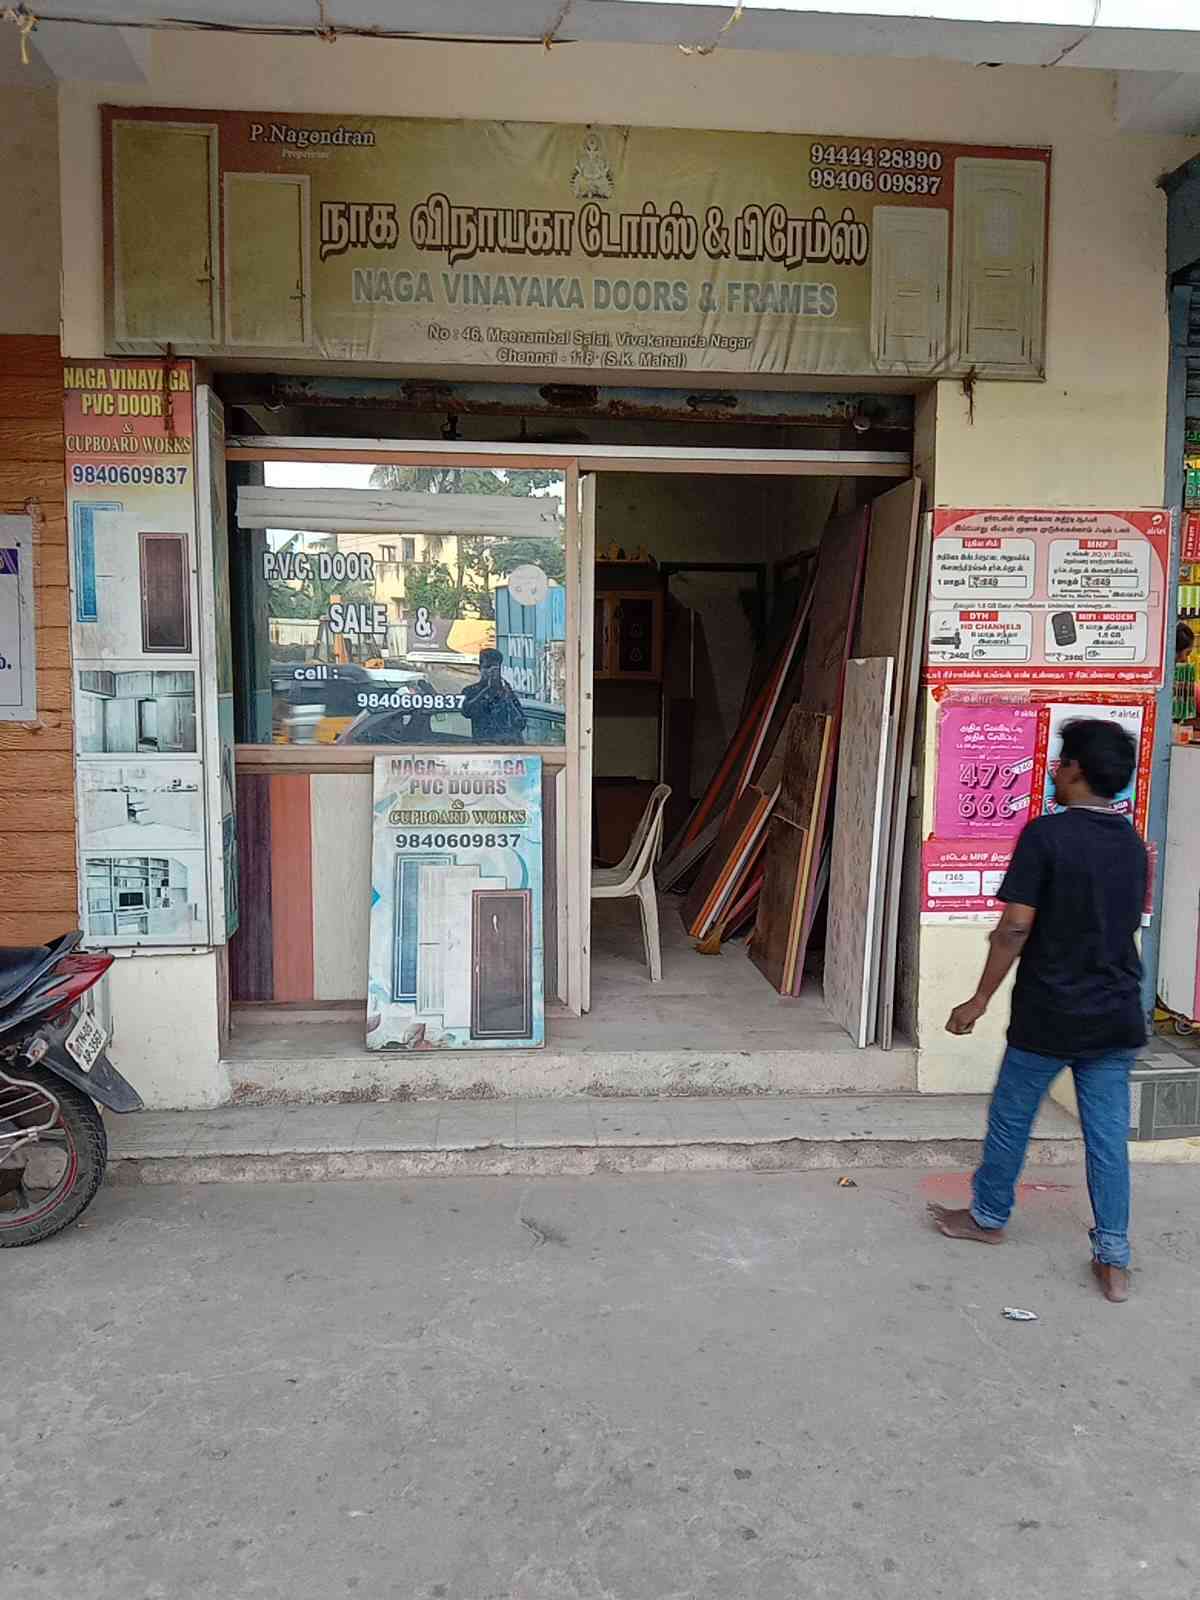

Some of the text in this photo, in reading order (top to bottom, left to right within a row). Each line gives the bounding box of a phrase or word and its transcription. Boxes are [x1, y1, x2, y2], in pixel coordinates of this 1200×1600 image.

[250, 123, 376, 148] P.Nagendran
[810, 144, 942, 171] 94444 28390
[809, 169, 941, 195] 98406 09837
[320, 193, 869, 271] நாக விநாயகா டோர்ஸ் & பிரேம்ஸ்
[351, 268, 838, 317] NAGA VINAYAKA DOORS & FRAMES
[487, 327, 569, 346] Meenambal
[616, 331, 706, 350] Vivekananda
[710, 333, 753, 352] Nagar
[496, 348, 558, 365] Chennai
[63, 367, 108, 390] NAGA
[82, 393, 115, 416] PVC
[122, 423, 135, 434] &
[65, 435, 193, 455] CUPBOARD WORKS
[72, 465, 187, 485] 9840609837
[263, 552, 374, 581] P.V.C. DOOR
[329, 603, 432, 637] SALE &
[968, 612, 990, 620] DTH
[357, 693, 466, 709] 9840609837
[410, 779, 507, 795] PVC DOORS
[388, 810, 527, 824] CUPBOARD WORKS
[396, 833, 521, 849] 9840609837
